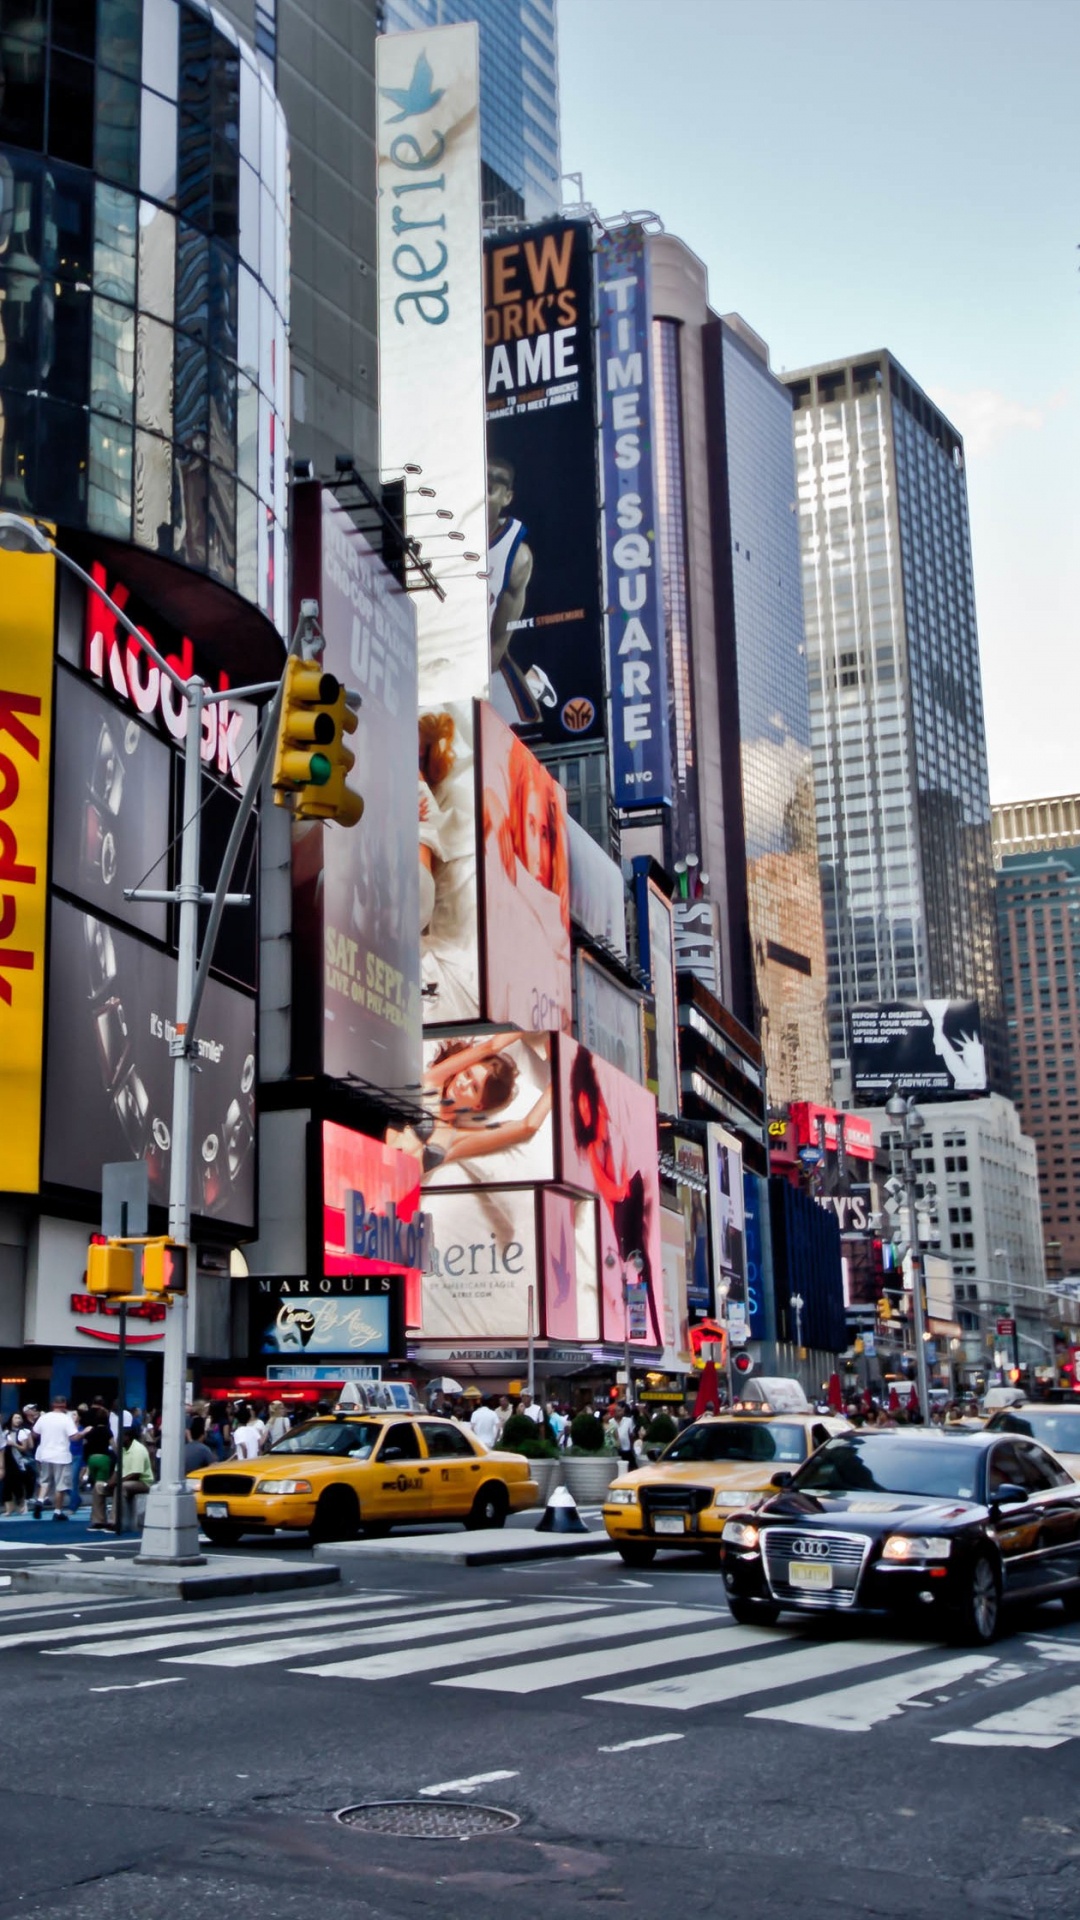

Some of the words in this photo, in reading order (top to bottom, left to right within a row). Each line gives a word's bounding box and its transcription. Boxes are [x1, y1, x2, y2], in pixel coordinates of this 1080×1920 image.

[389, 128, 449, 326] aerie
[483, 229, 575, 306] EW
[604, 276, 643, 470] TIMES
[612, 493, 653, 742] SQUARE
[351, 613, 399, 717] UFC
[624, 771, 652, 784] NYC
[325, 926, 361, 980] SAT.
[901, 1019, 930, 1027] WORLD
[898, 1078, 948, 1088] EADYNYC.ORG
[345, 1189, 403, 1266] Bank
[259, 1278, 391, 1292] MARQUIS
[443, 1281, 486, 1289] AMERICAN
[489, 1280, 515, 1288] EAGLE
[276, 1303, 316, 1331] Come
[307, 1298, 340, 1332] Fly
[449, 1351, 513, 1360] AMERICAN
